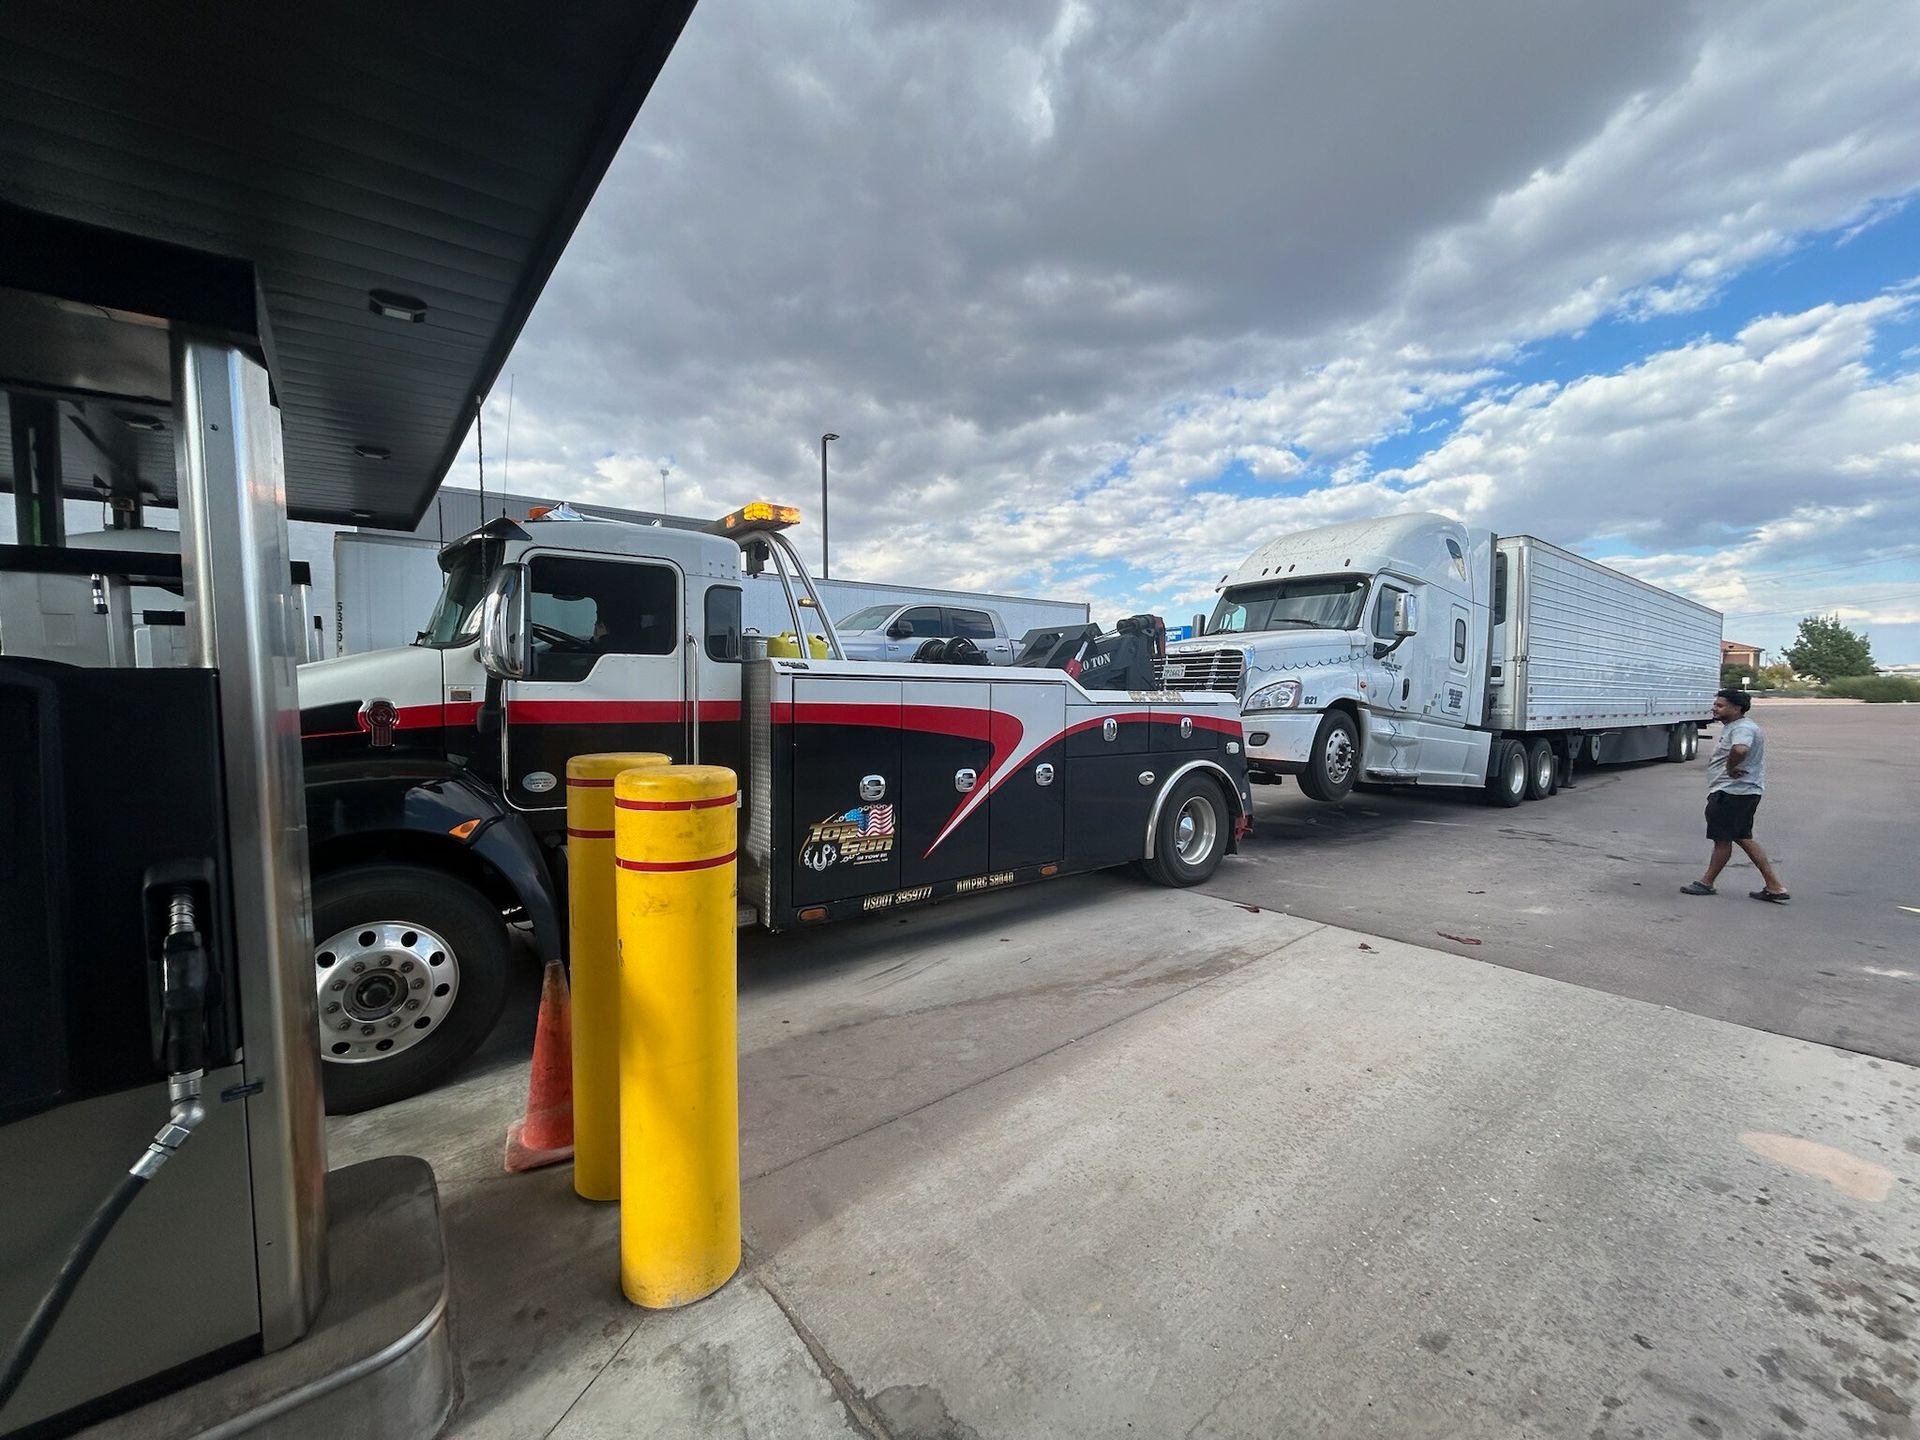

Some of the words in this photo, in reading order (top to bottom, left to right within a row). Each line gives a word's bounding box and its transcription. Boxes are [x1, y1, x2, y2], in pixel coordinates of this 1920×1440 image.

[1090, 652, 1112, 668] TON
[863, 894, 895, 911] USDOT
[895, 886, 933, 905] 3959777
